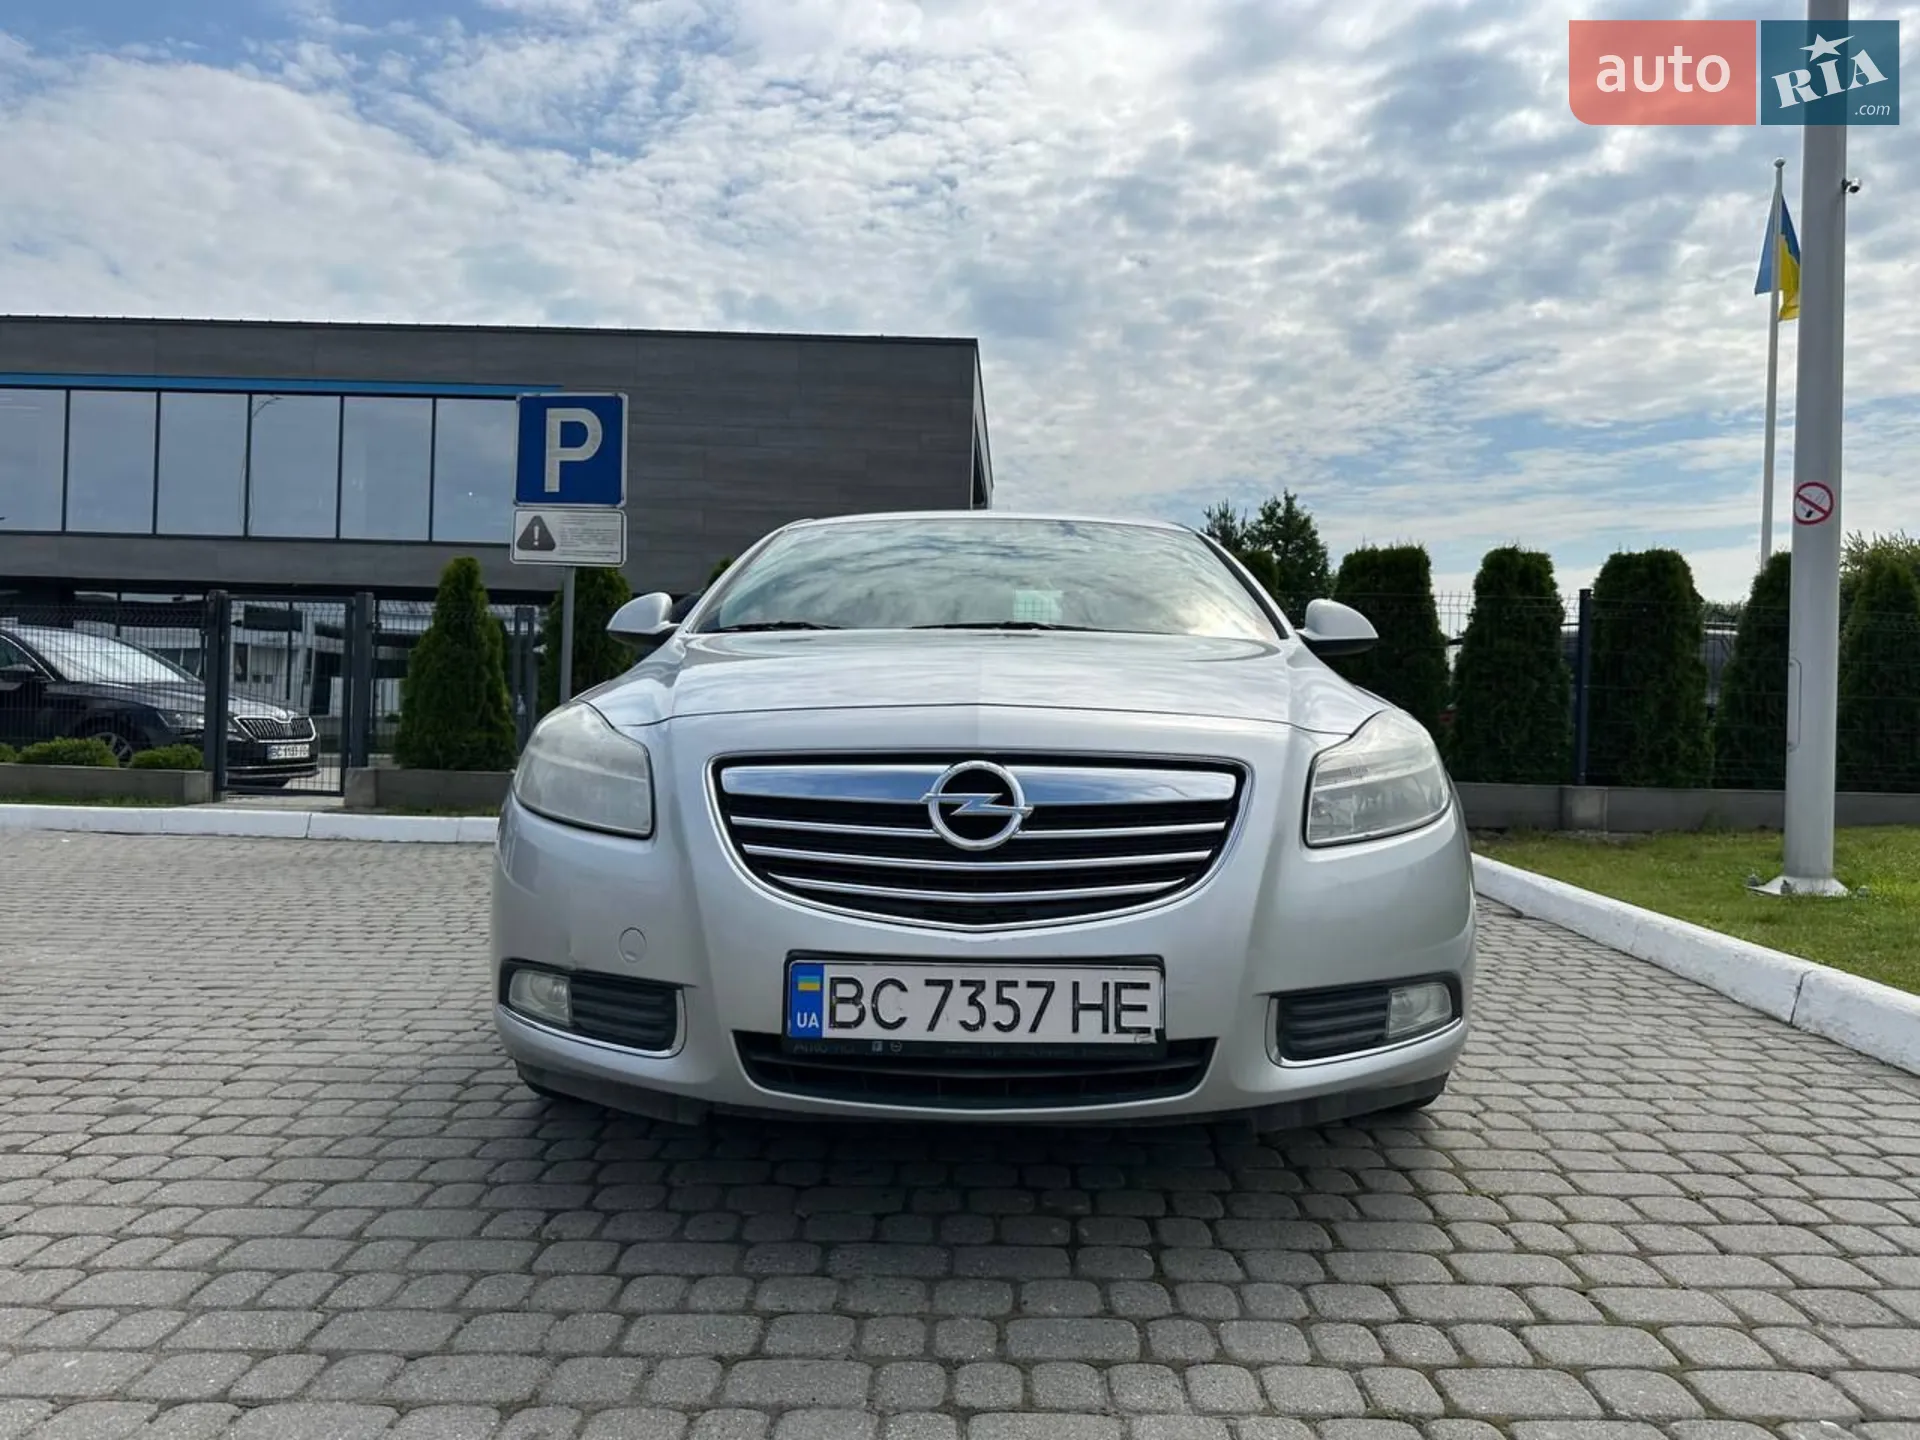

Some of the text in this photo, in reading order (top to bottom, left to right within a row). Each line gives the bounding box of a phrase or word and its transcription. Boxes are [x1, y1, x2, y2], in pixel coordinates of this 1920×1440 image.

[544, 408, 603, 492] P
[796, 1012, 820, 1029] UA
[828, 977, 1152, 1035] BC 7357 HE
